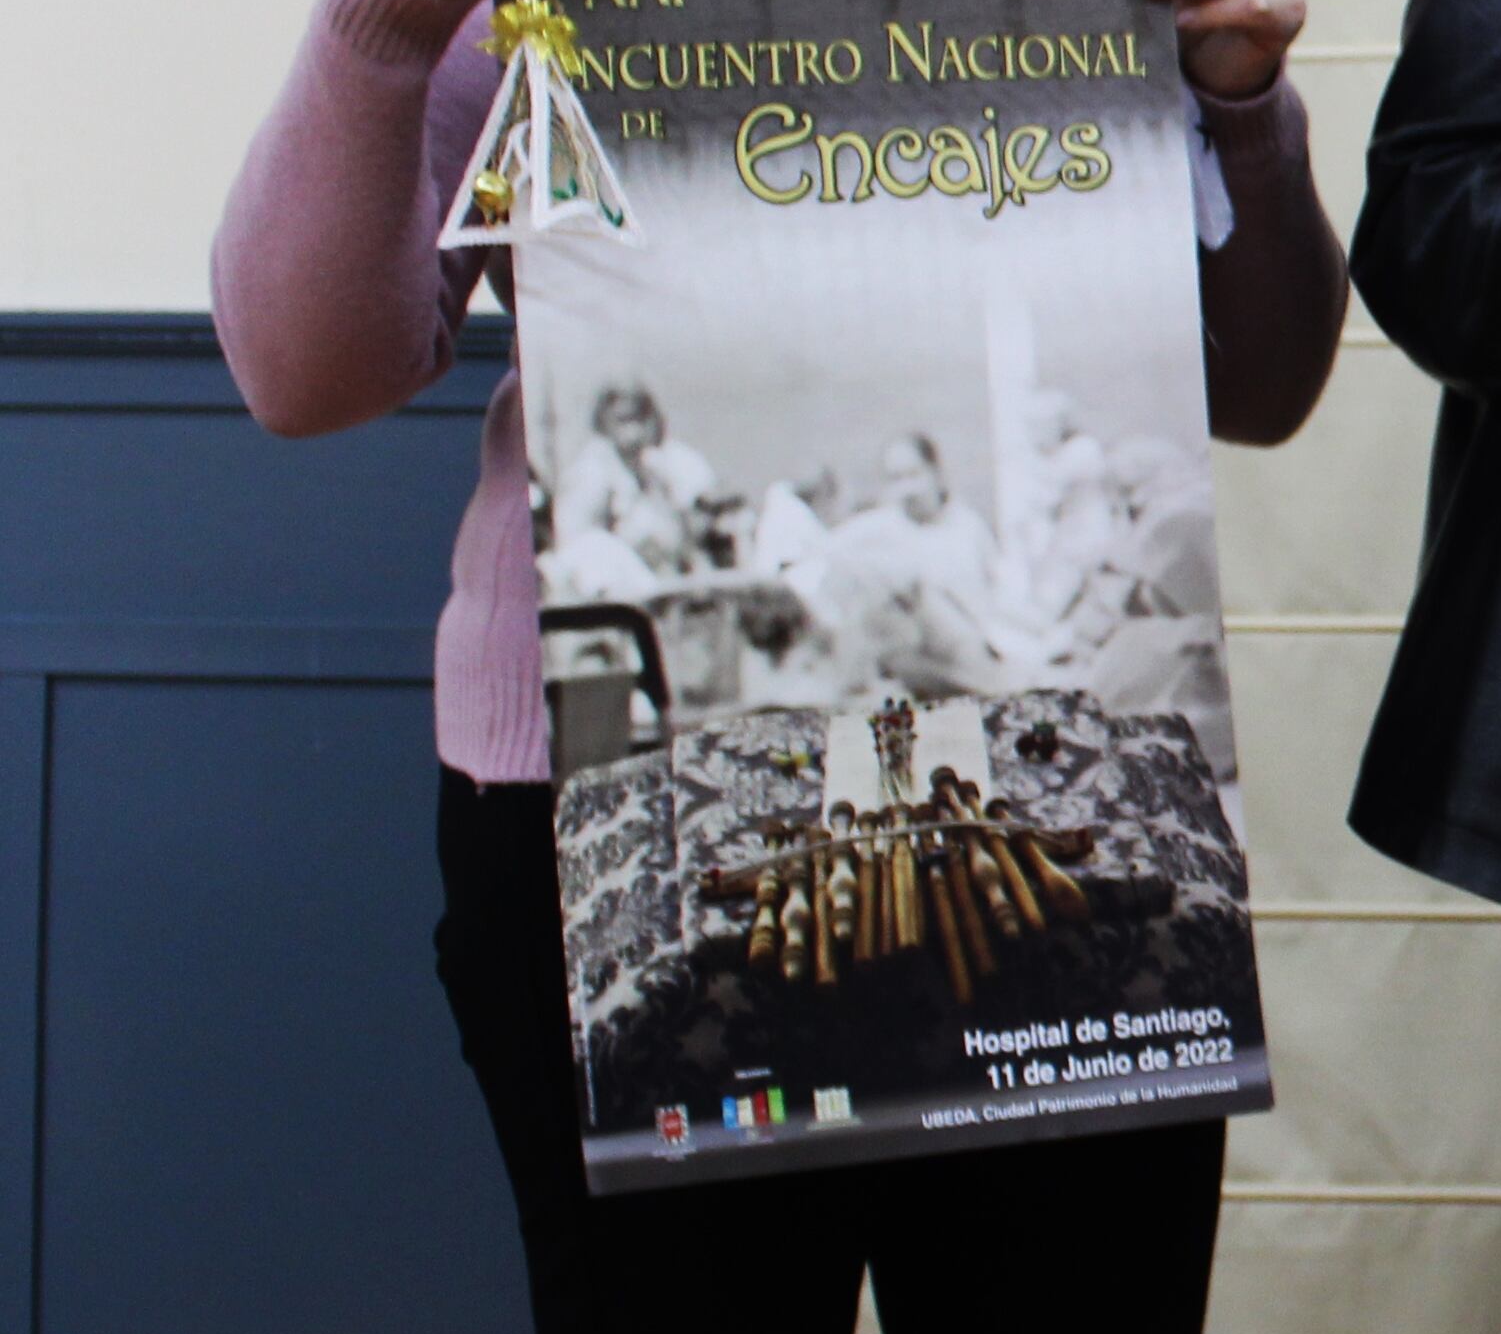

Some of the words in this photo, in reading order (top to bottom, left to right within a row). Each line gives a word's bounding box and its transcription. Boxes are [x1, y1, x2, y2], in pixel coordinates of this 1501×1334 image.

[575, 37, 864, 92] NCUENTRO
[884, 20, 1148, 85] NACIONAL
[621, 110, 666, 140] DE
[735, 100, 1113, 219] Encajes
[963, 1019, 1071, 1057] Hospital
[1075, 1017, 1108, 1044] de
[1112, 1006, 1231, 1039] Santiago,
[987, 1061, 1017, 1090] 11
[1023, 1059, 1056, 1086] de
[1062, 1050, 1133, 1082] Junio
[1138, 1046, 1169, 1072] de
[1174, 1037, 1234, 1067] 2022
[983, 1099, 1035, 1122] Ciudad
[1038, 1090, 1117, 1115] Patrimonio
[1120, 1089, 1138, 1105] de
[1141, 1085, 1155, 1101] la
[1158, 1076, 1238, 1100] Humanidad
